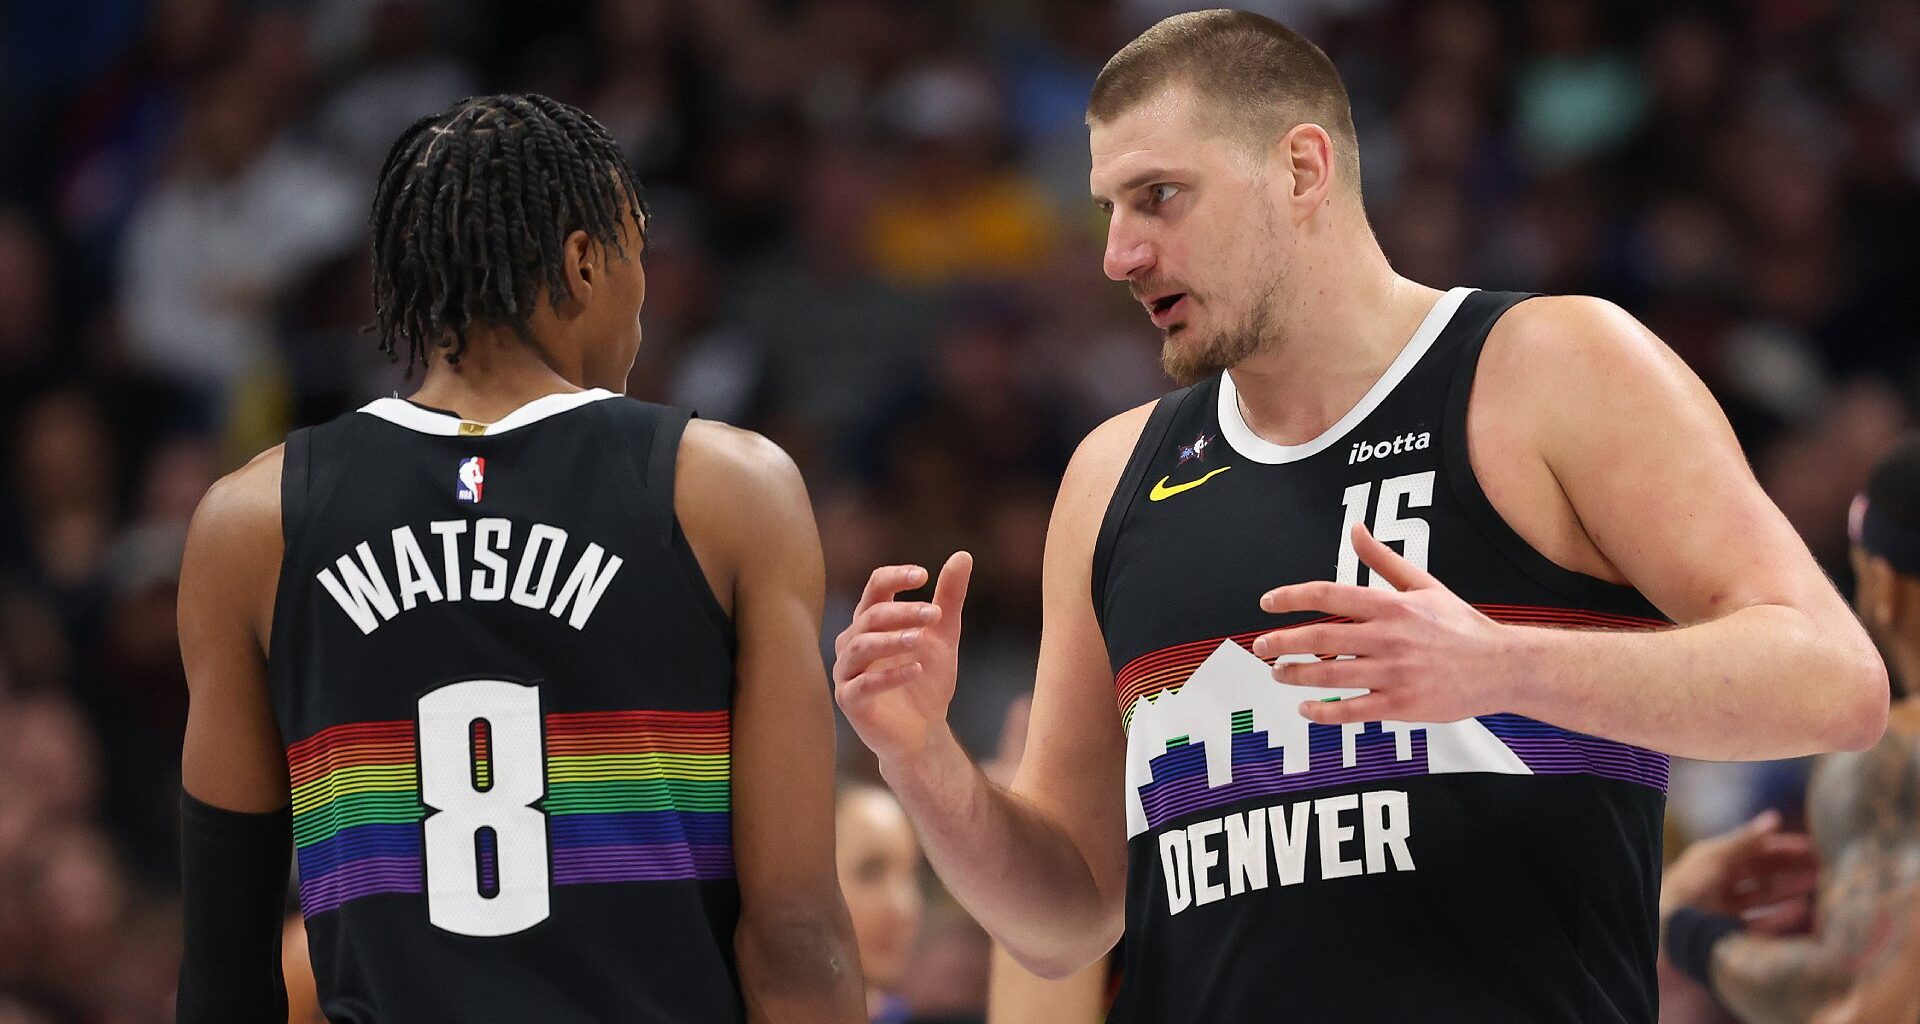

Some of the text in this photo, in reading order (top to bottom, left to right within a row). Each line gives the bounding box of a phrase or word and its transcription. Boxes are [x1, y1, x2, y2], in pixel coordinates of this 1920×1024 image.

[1348, 431, 1431, 465] ibotta
[317, 518, 624, 635] WATSON
[1335, 470, 1436, 592] 15
[417, 679, 550, 937] 8
[1158, 790, 1416, 916] DENVER
